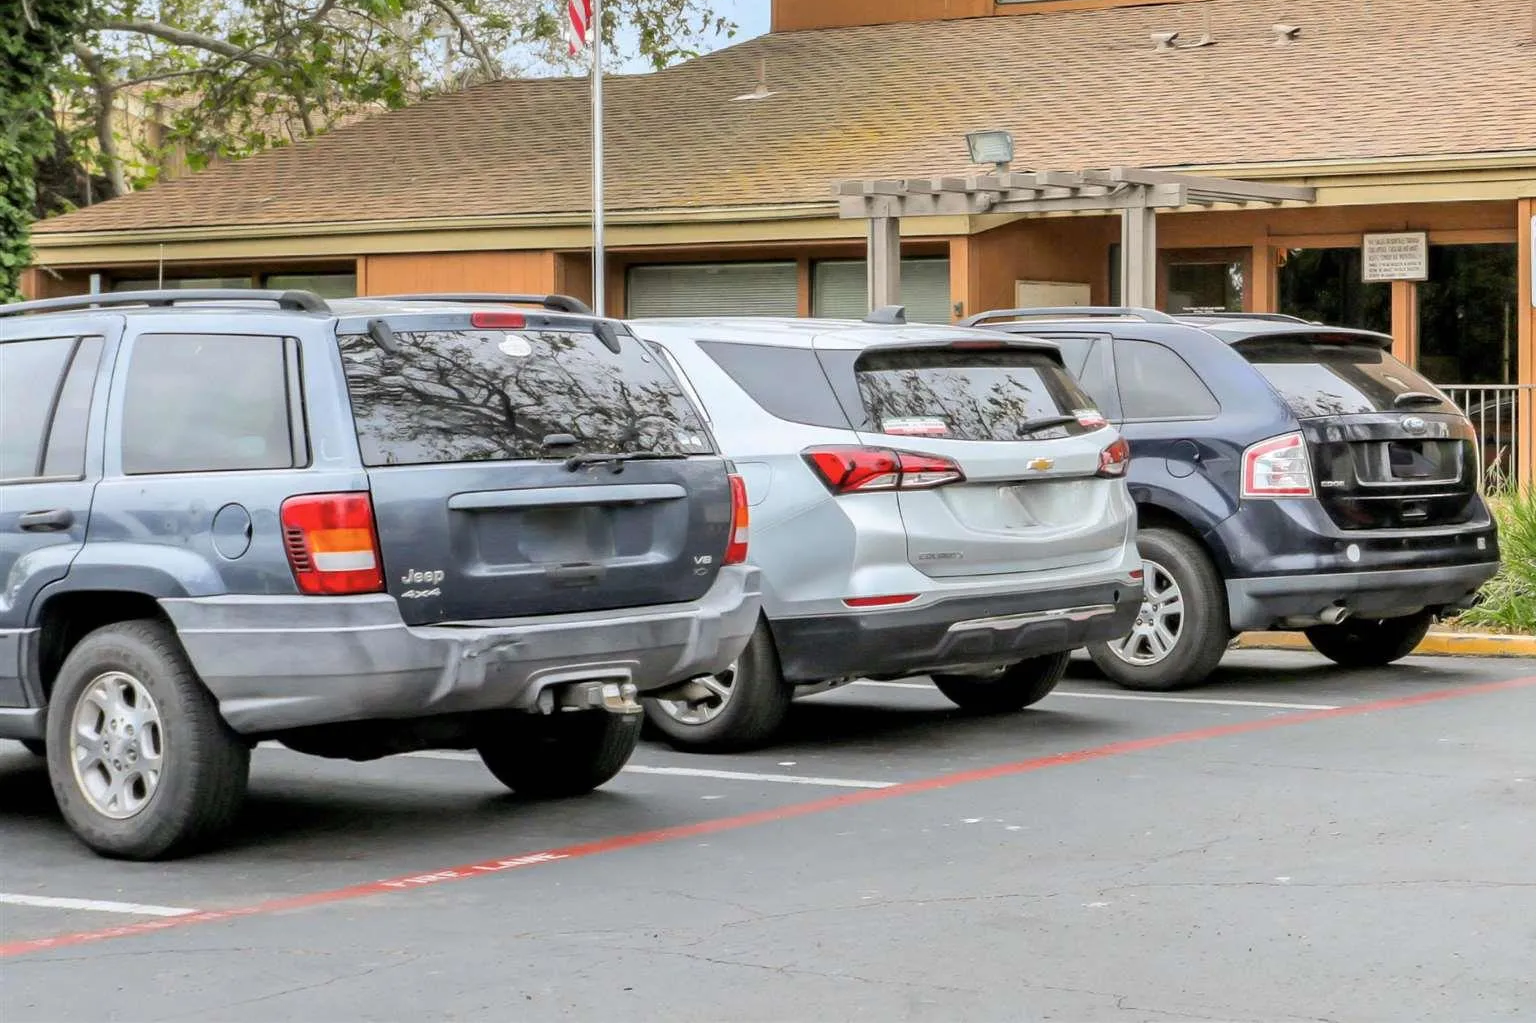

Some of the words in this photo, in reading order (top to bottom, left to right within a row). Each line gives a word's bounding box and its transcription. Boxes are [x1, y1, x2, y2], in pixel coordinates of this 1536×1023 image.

[694, 555, 713, 564] V8
[401, 568, 445, 585] Jeep
[471, 852, 569, 871] LANE
